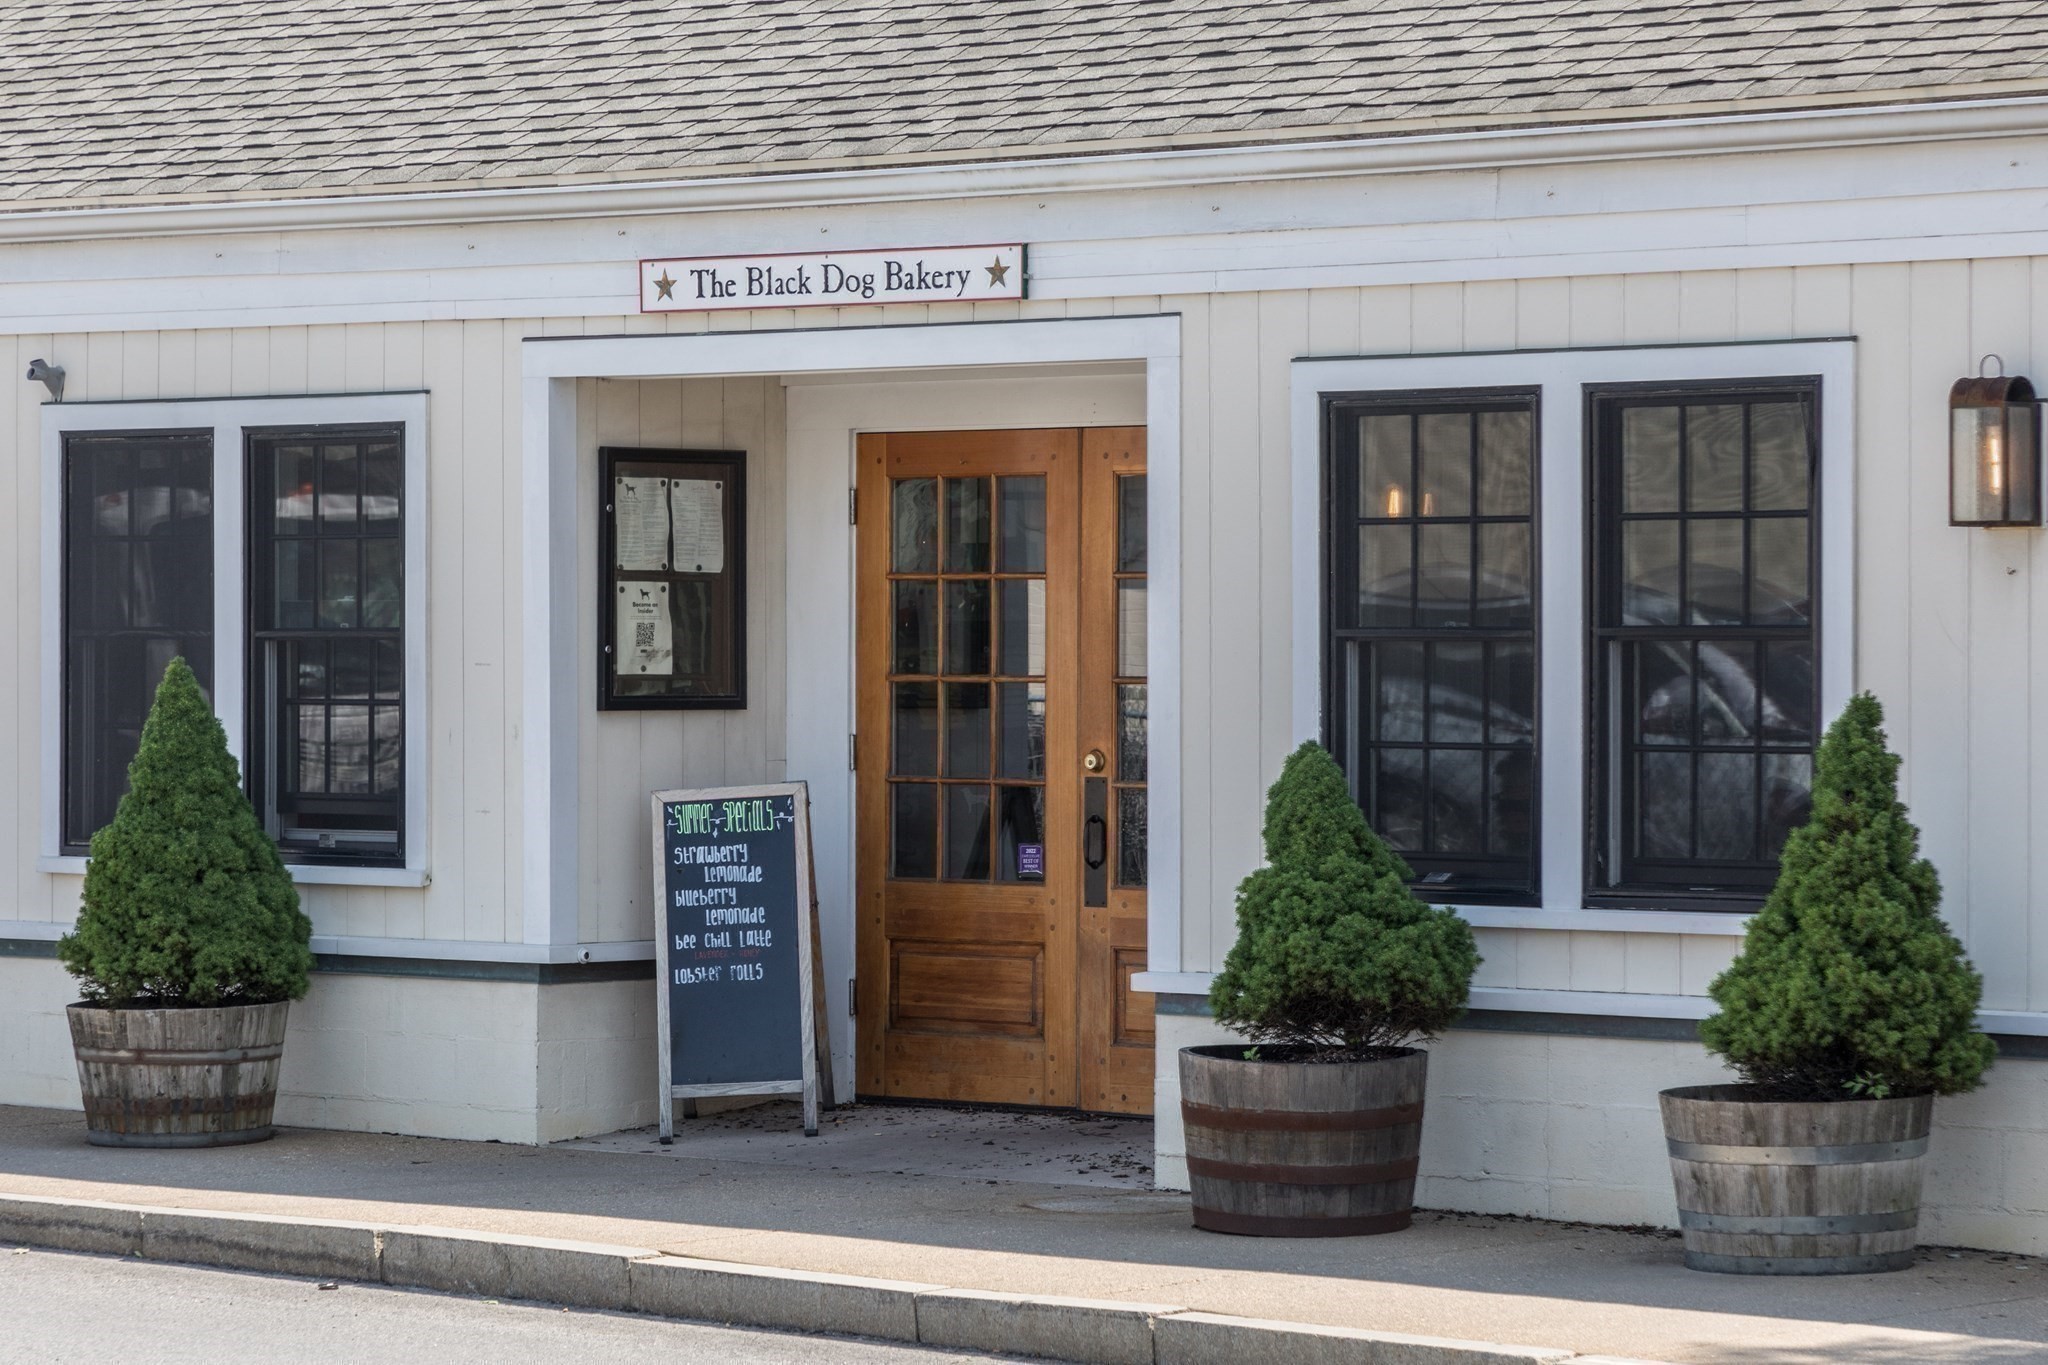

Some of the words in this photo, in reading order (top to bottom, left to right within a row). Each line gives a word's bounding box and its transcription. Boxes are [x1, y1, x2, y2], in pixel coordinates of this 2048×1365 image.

[690, 268, 737, 299] The
[745, 264, 813, 298] Black
[820, 263, 875, 299] Dog
[884, 260, 972, 298] Bakery
[674, 843, 748, 865] Strawberry
[704, 865, 763, 883] Lemonade
[675, 887, 737, 907] blueberry
[705, 906, 766, 926] Lemonade
[675, 934, 697, 950] bee
